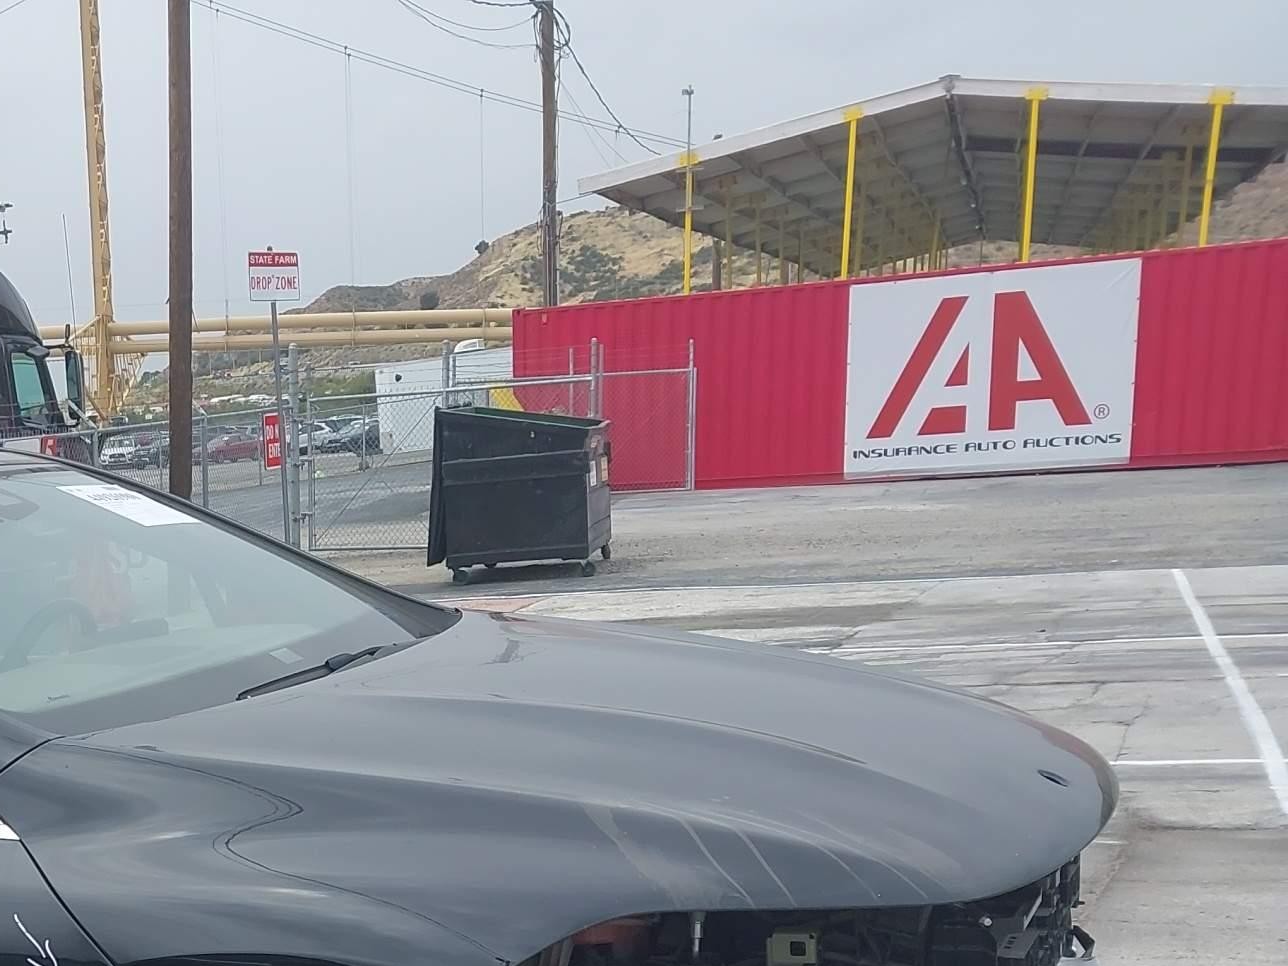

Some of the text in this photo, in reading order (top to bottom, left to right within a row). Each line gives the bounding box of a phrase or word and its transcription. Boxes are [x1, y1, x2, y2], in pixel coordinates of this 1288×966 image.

[249, 255, 297, 264] STATE FARM
[251, 276, 297, 290] DROP ZONE
[852, 433, 1122, 460] INSURANCE AUTO AUCTIONS
